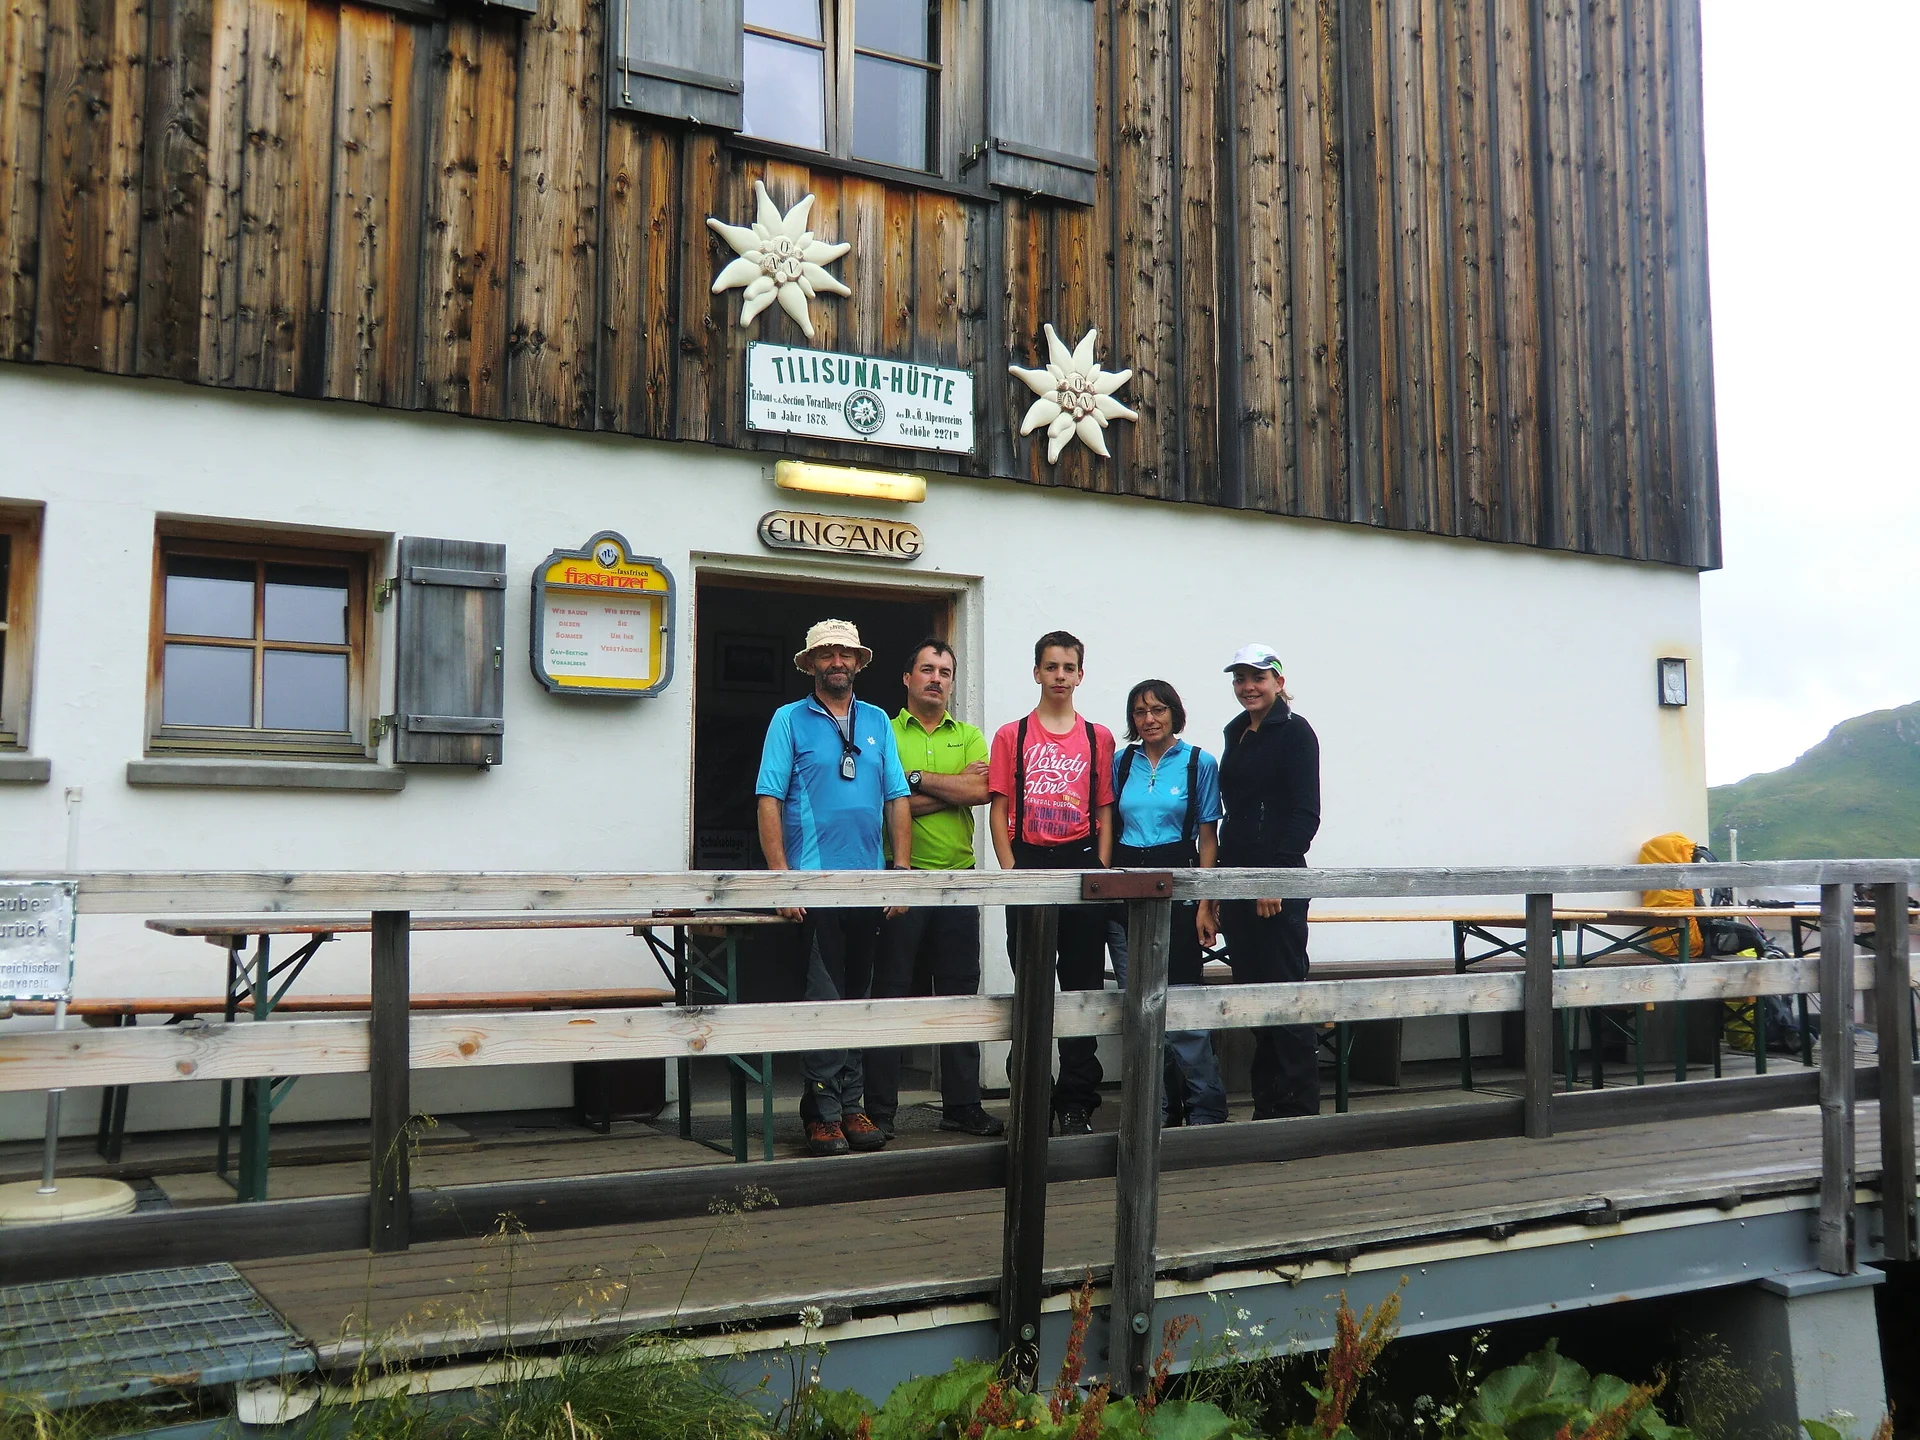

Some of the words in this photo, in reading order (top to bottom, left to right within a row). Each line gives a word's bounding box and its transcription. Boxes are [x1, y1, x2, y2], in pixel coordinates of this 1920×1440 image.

[771, 356, 956, 406] TILISUNA-HÜTTE
[767, 409, 776, 420] im
[781, 410, 801, 422] Jahre
[783, 393, 805, 406] Section
[806, 394, 842, 413] Vorarlberg
[899, 423, 930, 437] Seehöhe
[925, 411, 963, 425] Alpenvereins
[767, 517, 919, 554] EINGANG
[1024, 742, 1088, 782] Variety
[1024, 769, 1067, 800] Store
